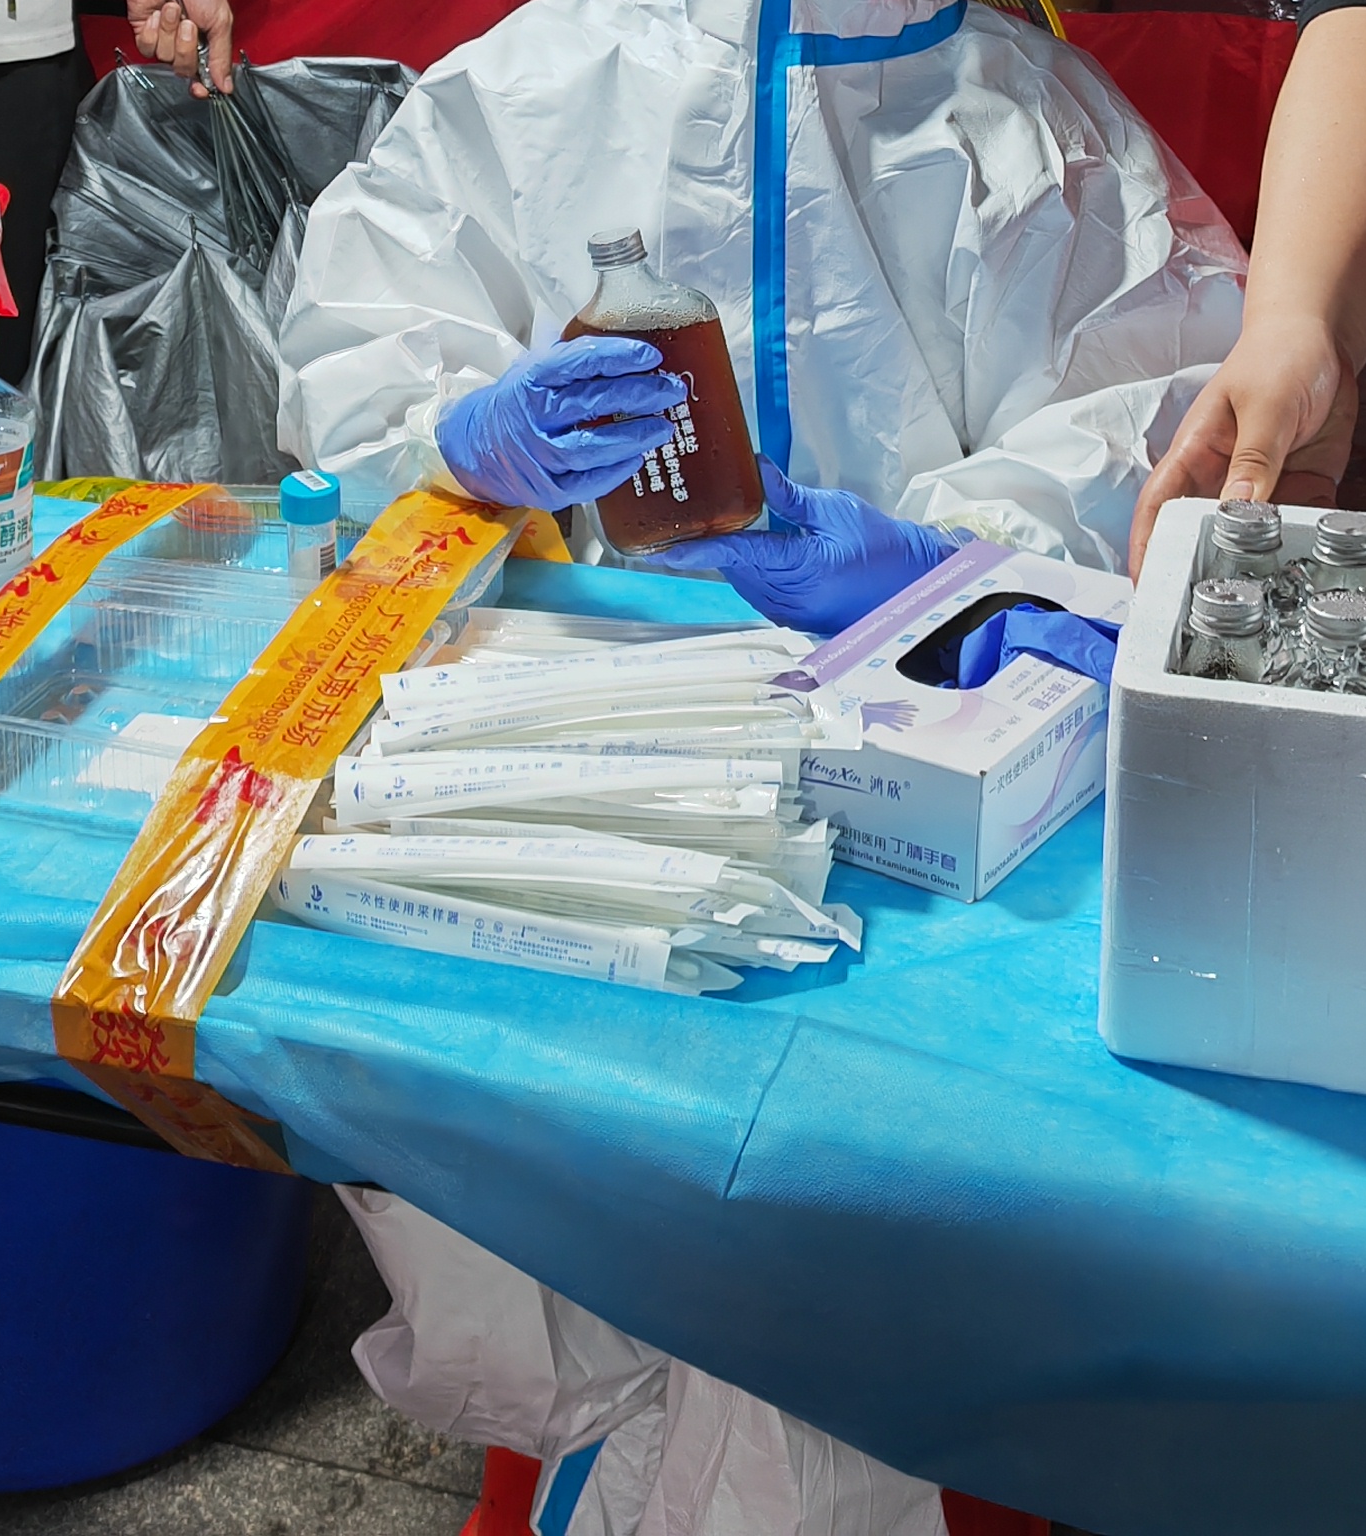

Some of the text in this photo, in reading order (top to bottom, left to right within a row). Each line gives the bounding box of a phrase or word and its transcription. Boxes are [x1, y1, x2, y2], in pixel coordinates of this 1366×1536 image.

[848, 848, 874, 862] Nitrile
[875, 855, 929, 880] Examination
[930, 873, 960, 891] Gloves
[346, 891, 459, 925] 一次性使用采样器
